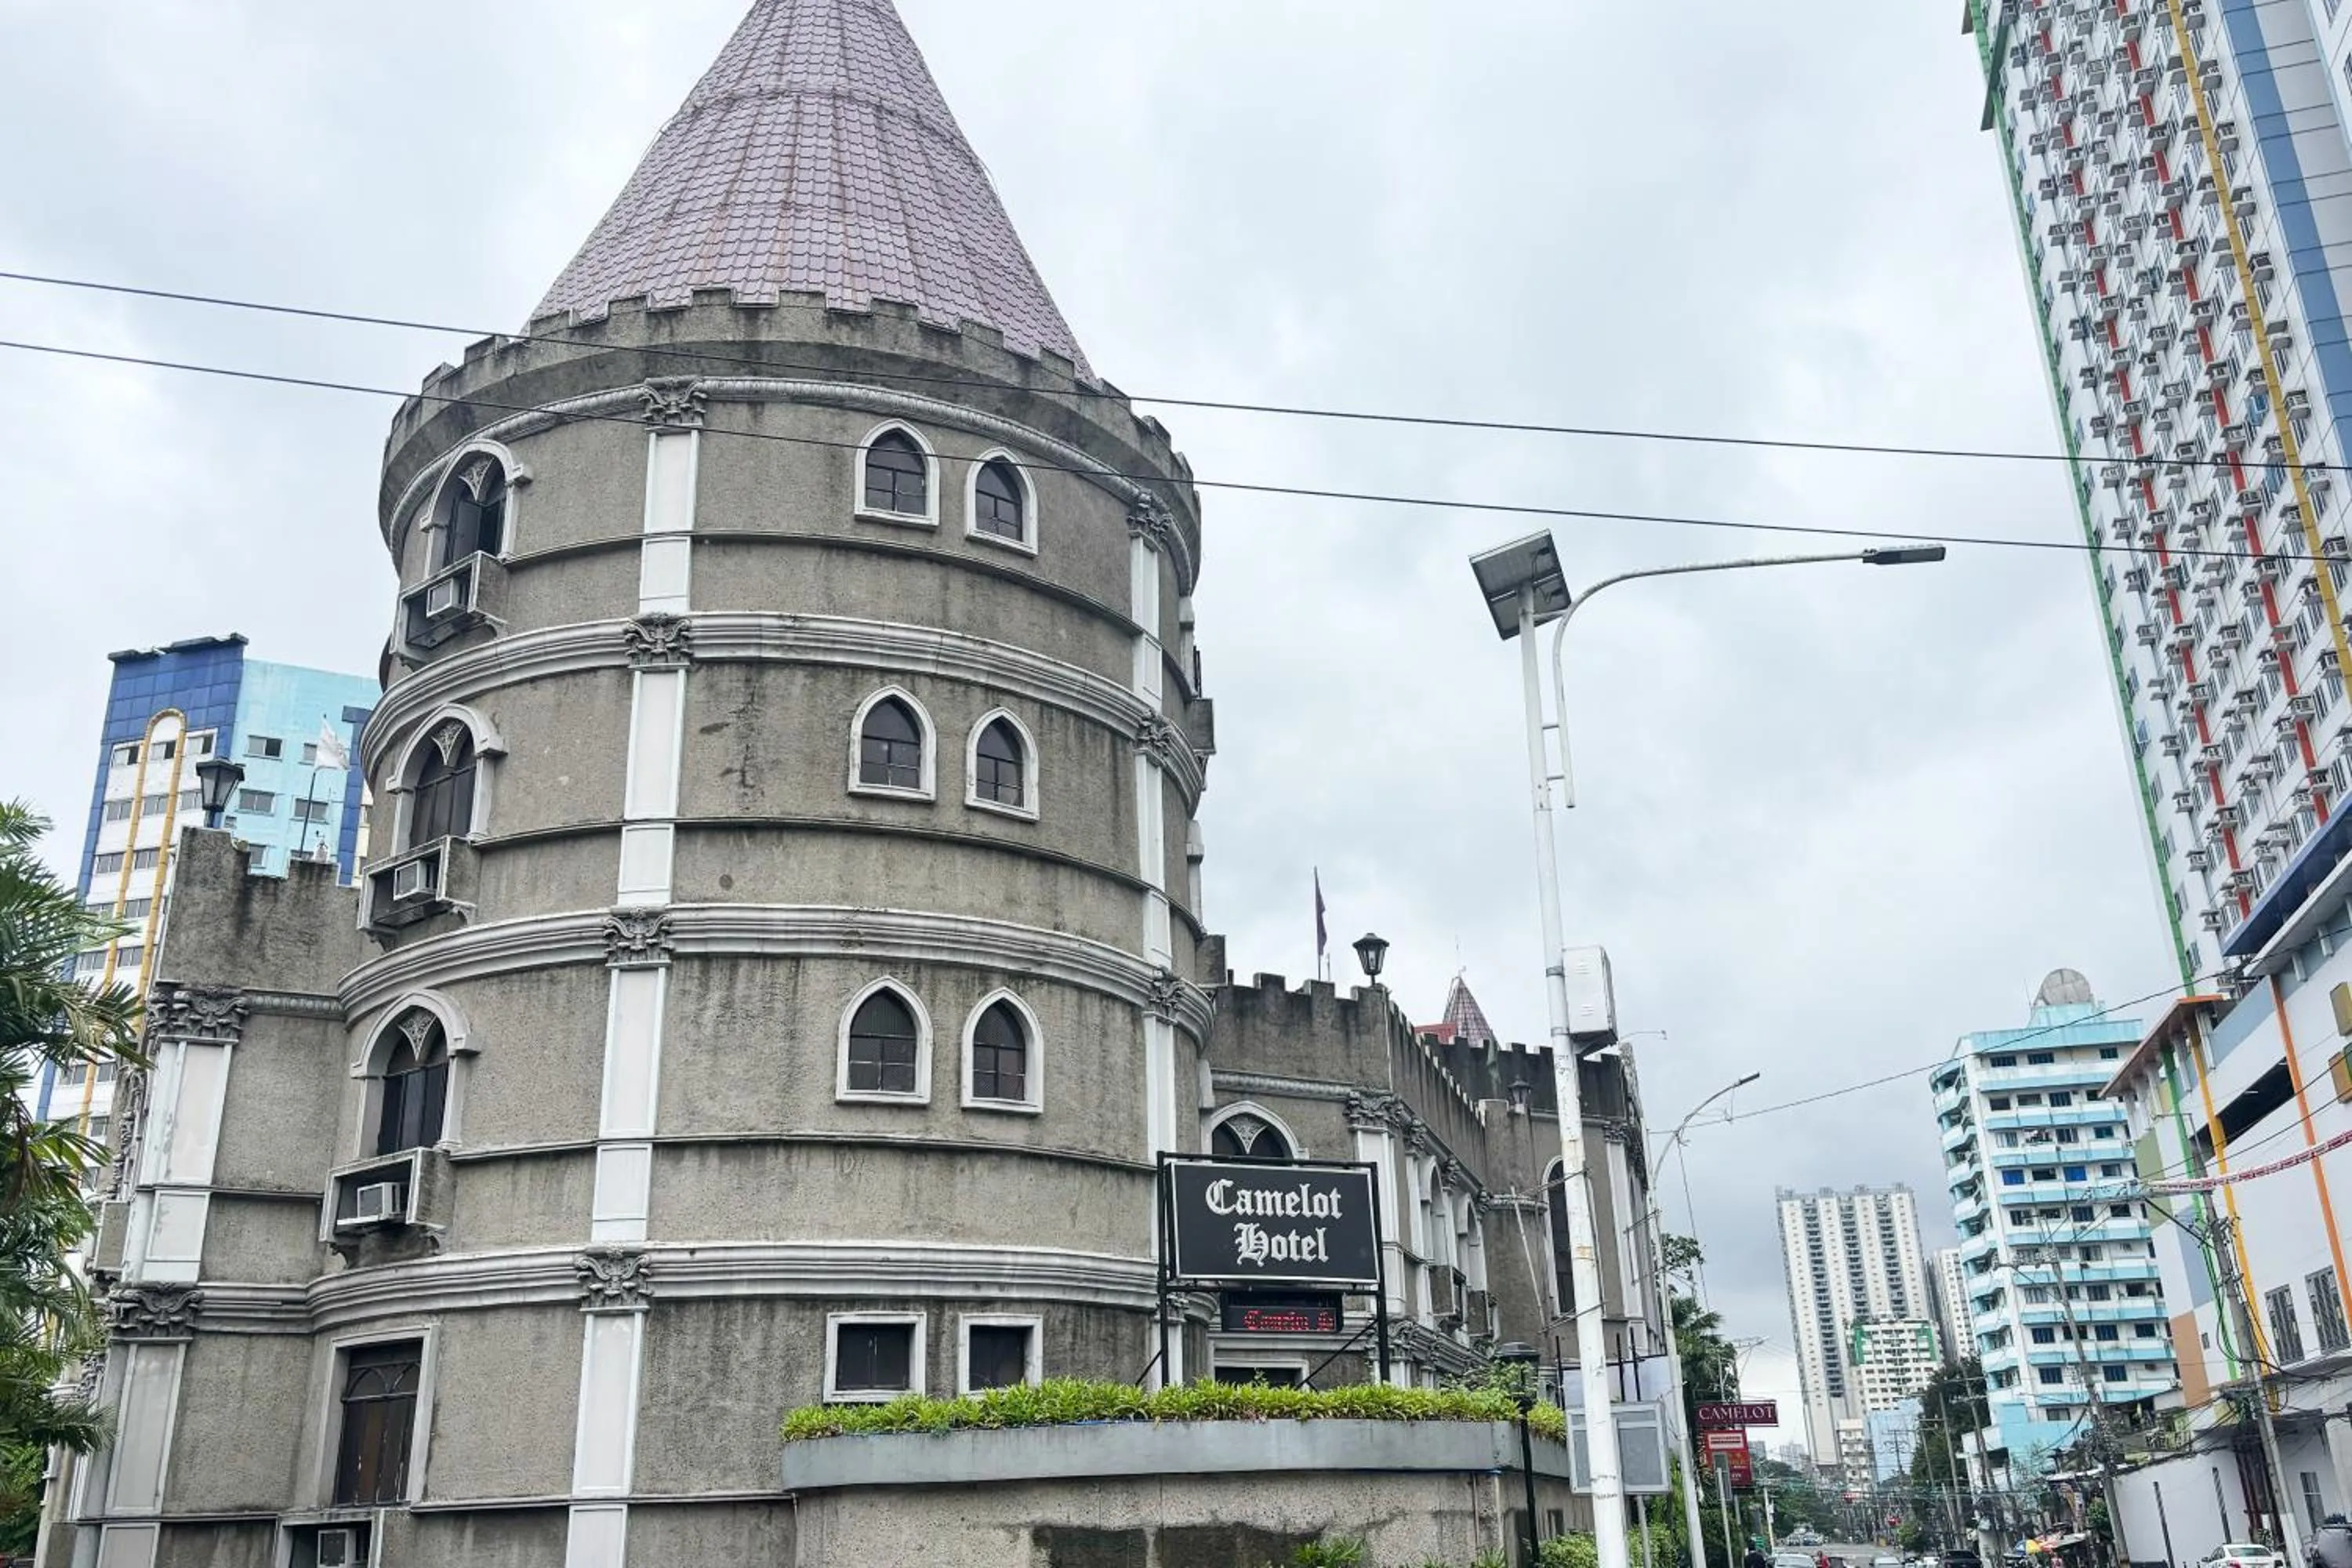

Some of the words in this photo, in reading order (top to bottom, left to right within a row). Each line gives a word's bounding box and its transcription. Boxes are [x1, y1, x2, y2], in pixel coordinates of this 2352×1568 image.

[1206, 1178, 1343, 1219] Camelot
[1234, 1222, 1329, 1267] Hotel
[1699, 1406, 1773, 1420] CAMELOT
